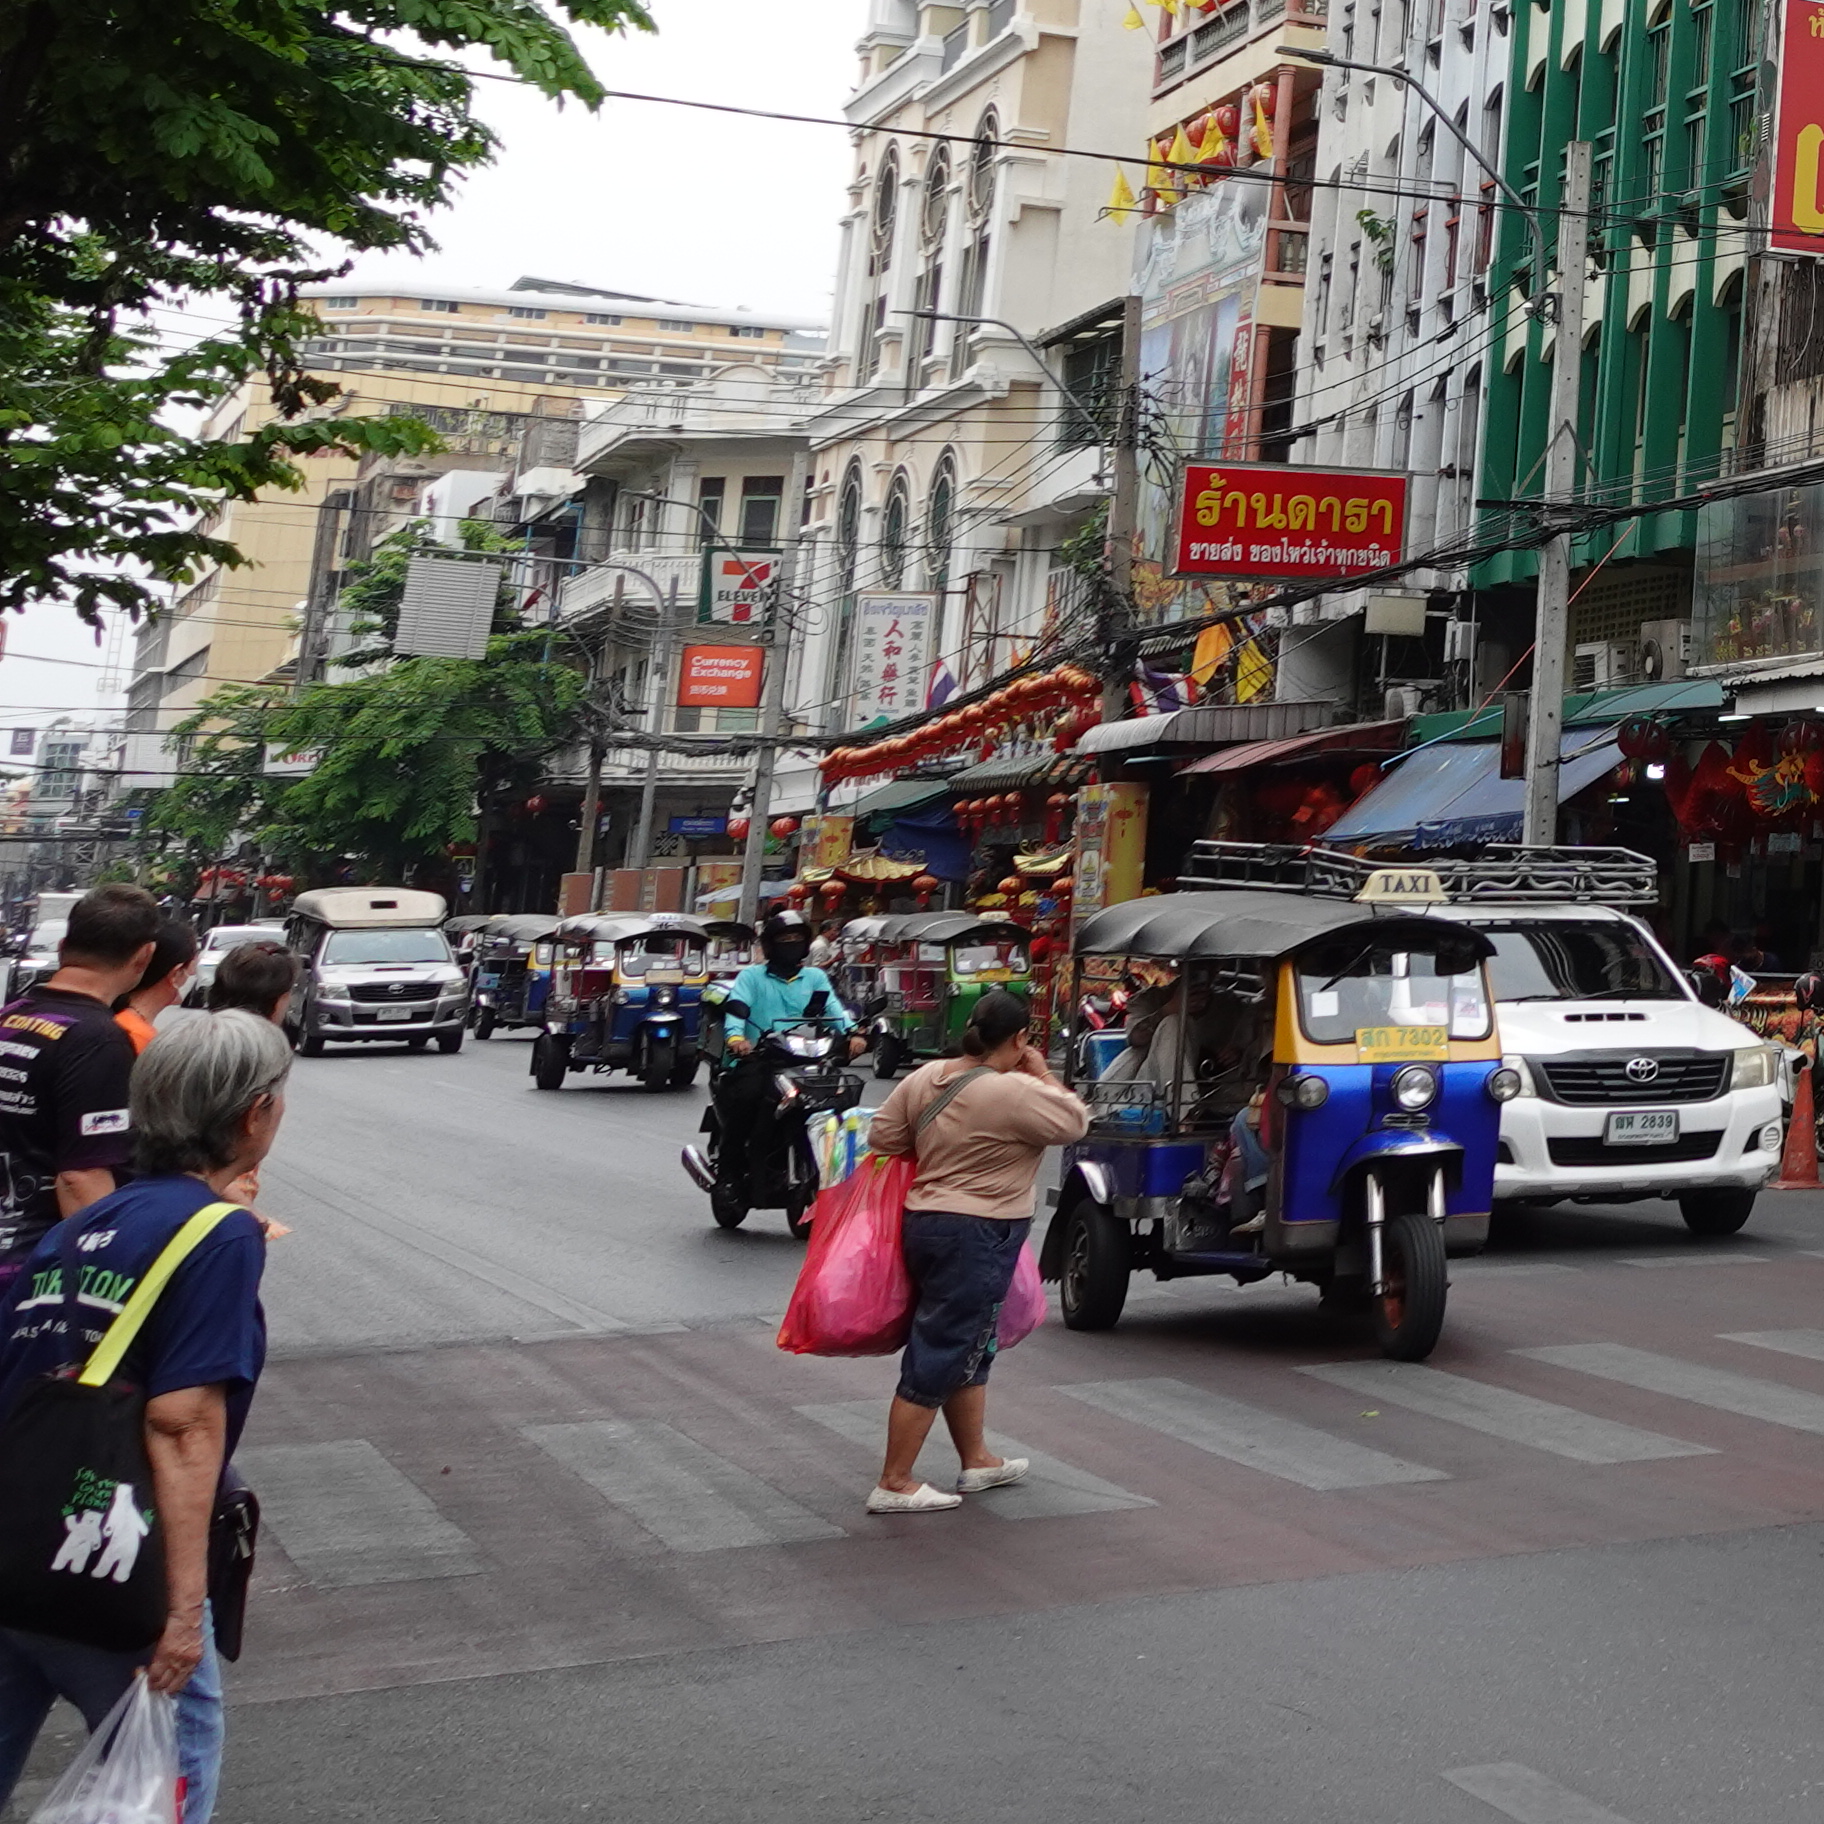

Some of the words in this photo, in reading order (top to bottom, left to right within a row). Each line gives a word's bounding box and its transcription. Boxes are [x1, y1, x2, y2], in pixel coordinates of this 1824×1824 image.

[1195, 472, 1393, 535] ร้านดารา
[1189, 537, 1243, 562] ขายส่ง
[722, 561, 771, 621] 7
[691, 655, 750, 670] Currency
[690, 666, 752, 680] Exchange
[1379, 874, 1432, 894] TAXI
[1396, 1027, 1444, 1047] 7302
[1640, 1114, 1672, 1130] 2839
